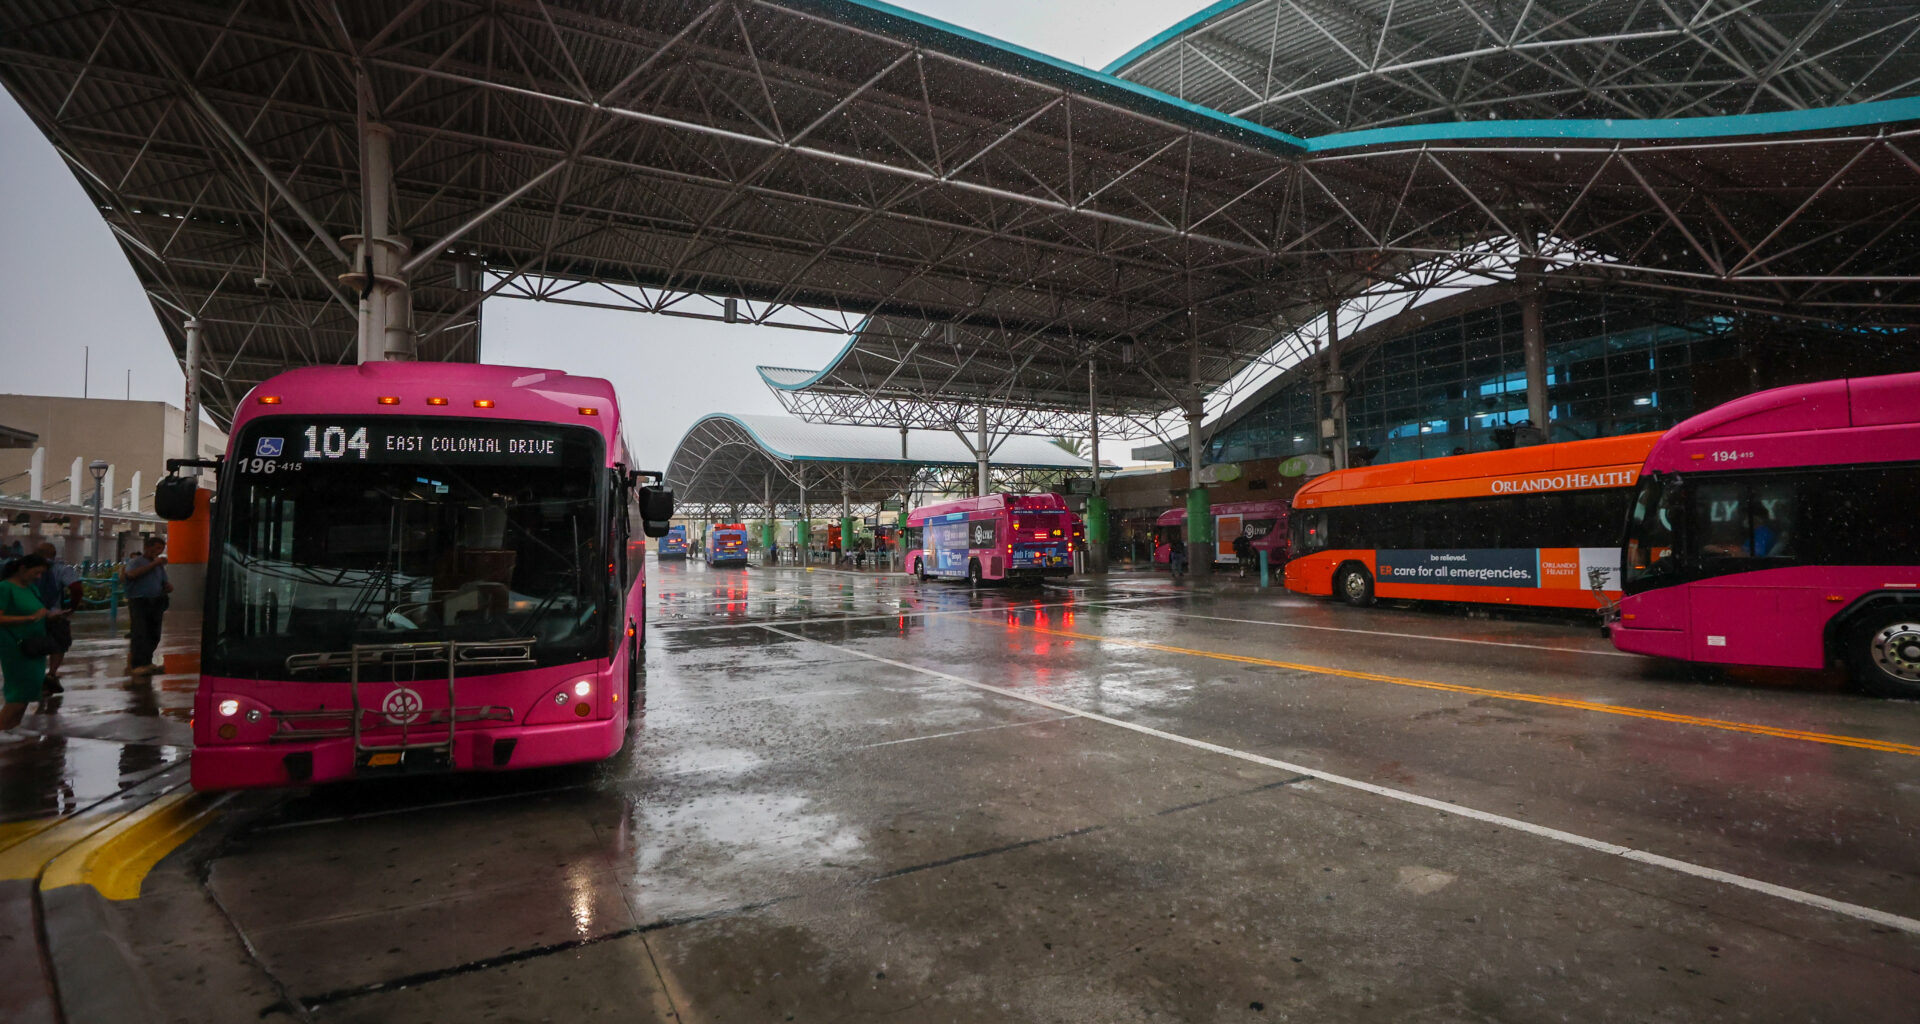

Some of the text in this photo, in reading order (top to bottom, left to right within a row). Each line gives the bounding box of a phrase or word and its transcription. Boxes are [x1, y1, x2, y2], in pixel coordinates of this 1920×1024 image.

[304, 425, 369, 459] 104
[386, 435, 555, 454] EAST COLONIAL DRIVE
[238, 457, 303, 473] 196-415
[1491, 471, 1632, 493] ORLANDO HEALTH
[1380, 565, 1532, 580] ER care for all emergencies.
[1542, 561, 1577, 569] ORLANDO
[1546, 568, 1574, 576] HEALTH
